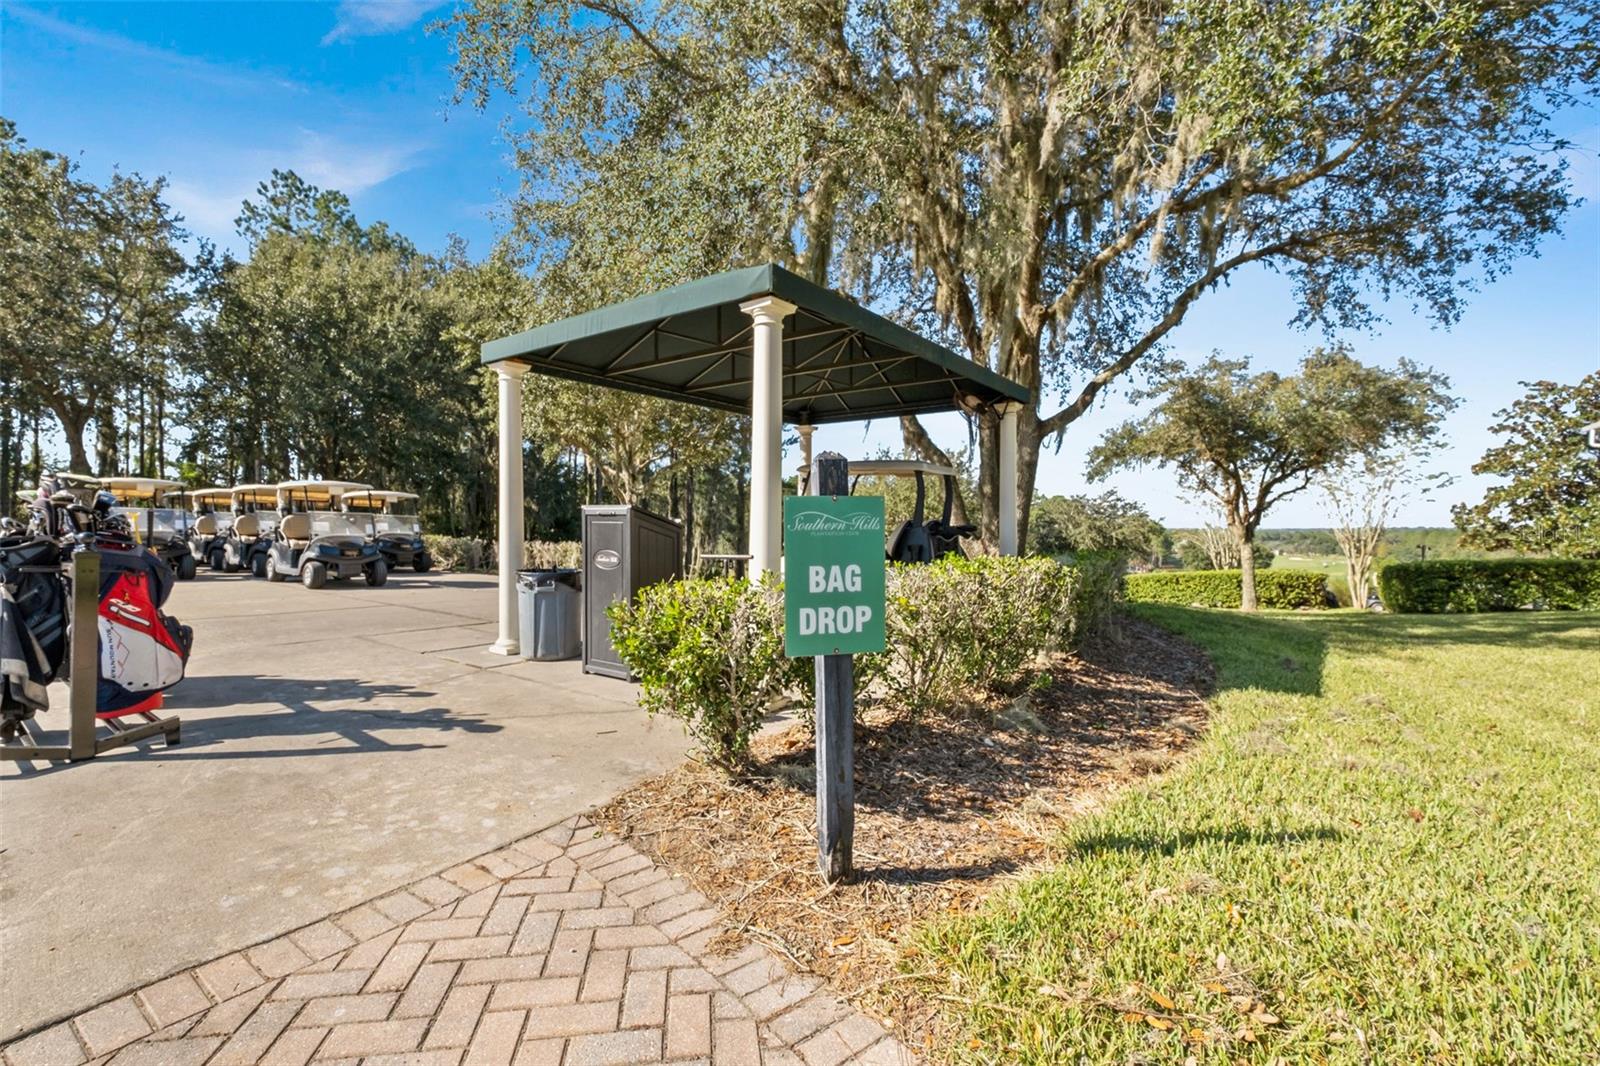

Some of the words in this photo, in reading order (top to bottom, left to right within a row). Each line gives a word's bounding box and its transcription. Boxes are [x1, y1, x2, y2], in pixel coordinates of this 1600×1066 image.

[787, 513, 847, 531] Southern
[849, 514, 881, 531] Hills
[809, 564, 862, 593] BAG
[799, 605, 872, 636] DROP
